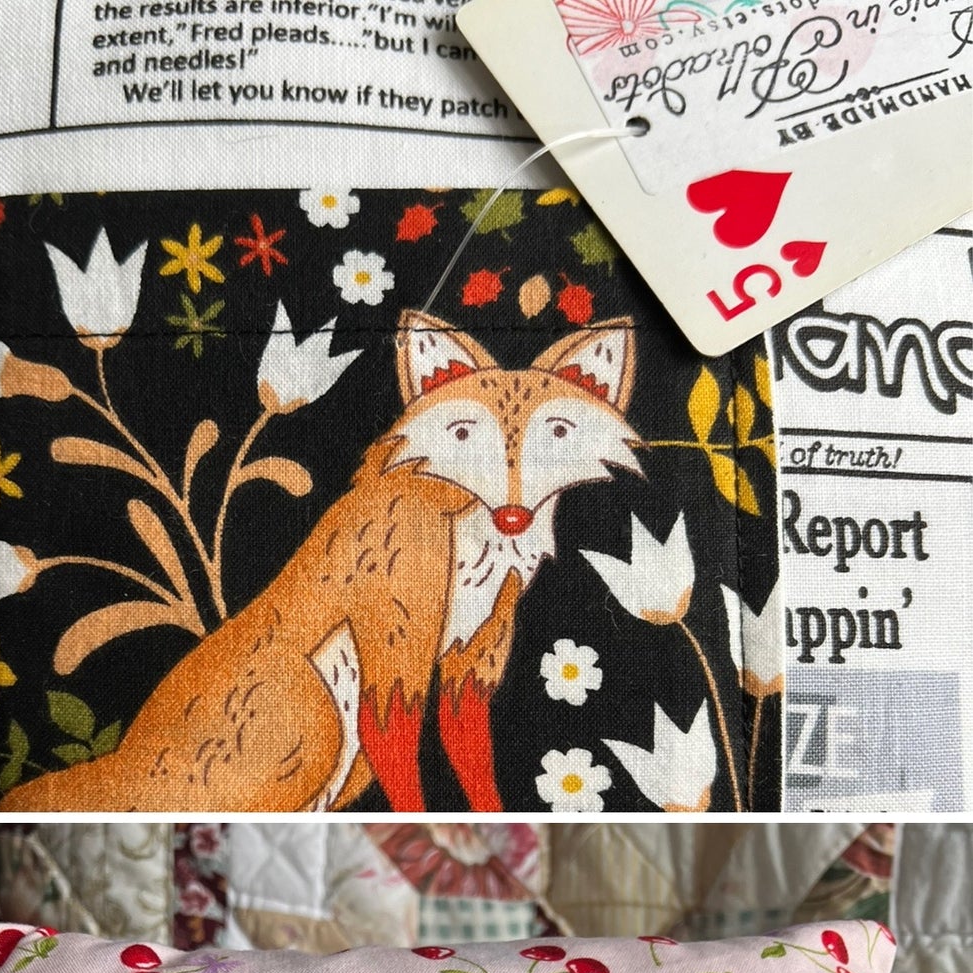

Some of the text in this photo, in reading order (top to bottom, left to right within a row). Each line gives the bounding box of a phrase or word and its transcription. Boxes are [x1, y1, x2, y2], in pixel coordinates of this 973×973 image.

[94, 1, 133, 21] the
[139, 0, 218, 17] results
[225, 0, 264, 15] are
[846, 3, 881, 33] in
[191, 22, 243, 42] Fred
[423, 38, 429, 55] I
[93, 53, 136, 77] and
[192, 80, 222, 102] let
[229, 84, 274, 105] you
[282, 80, 348, 104] know
[357, 85, 372, 106] if
[379, 88, 433, 116] they
[441, 97, 509, 119] patch
[777, 74, 972, 147] HANDMADE BY
[707, 264, 782, 321] 5
[790, 441, 903, 470] of truth!
